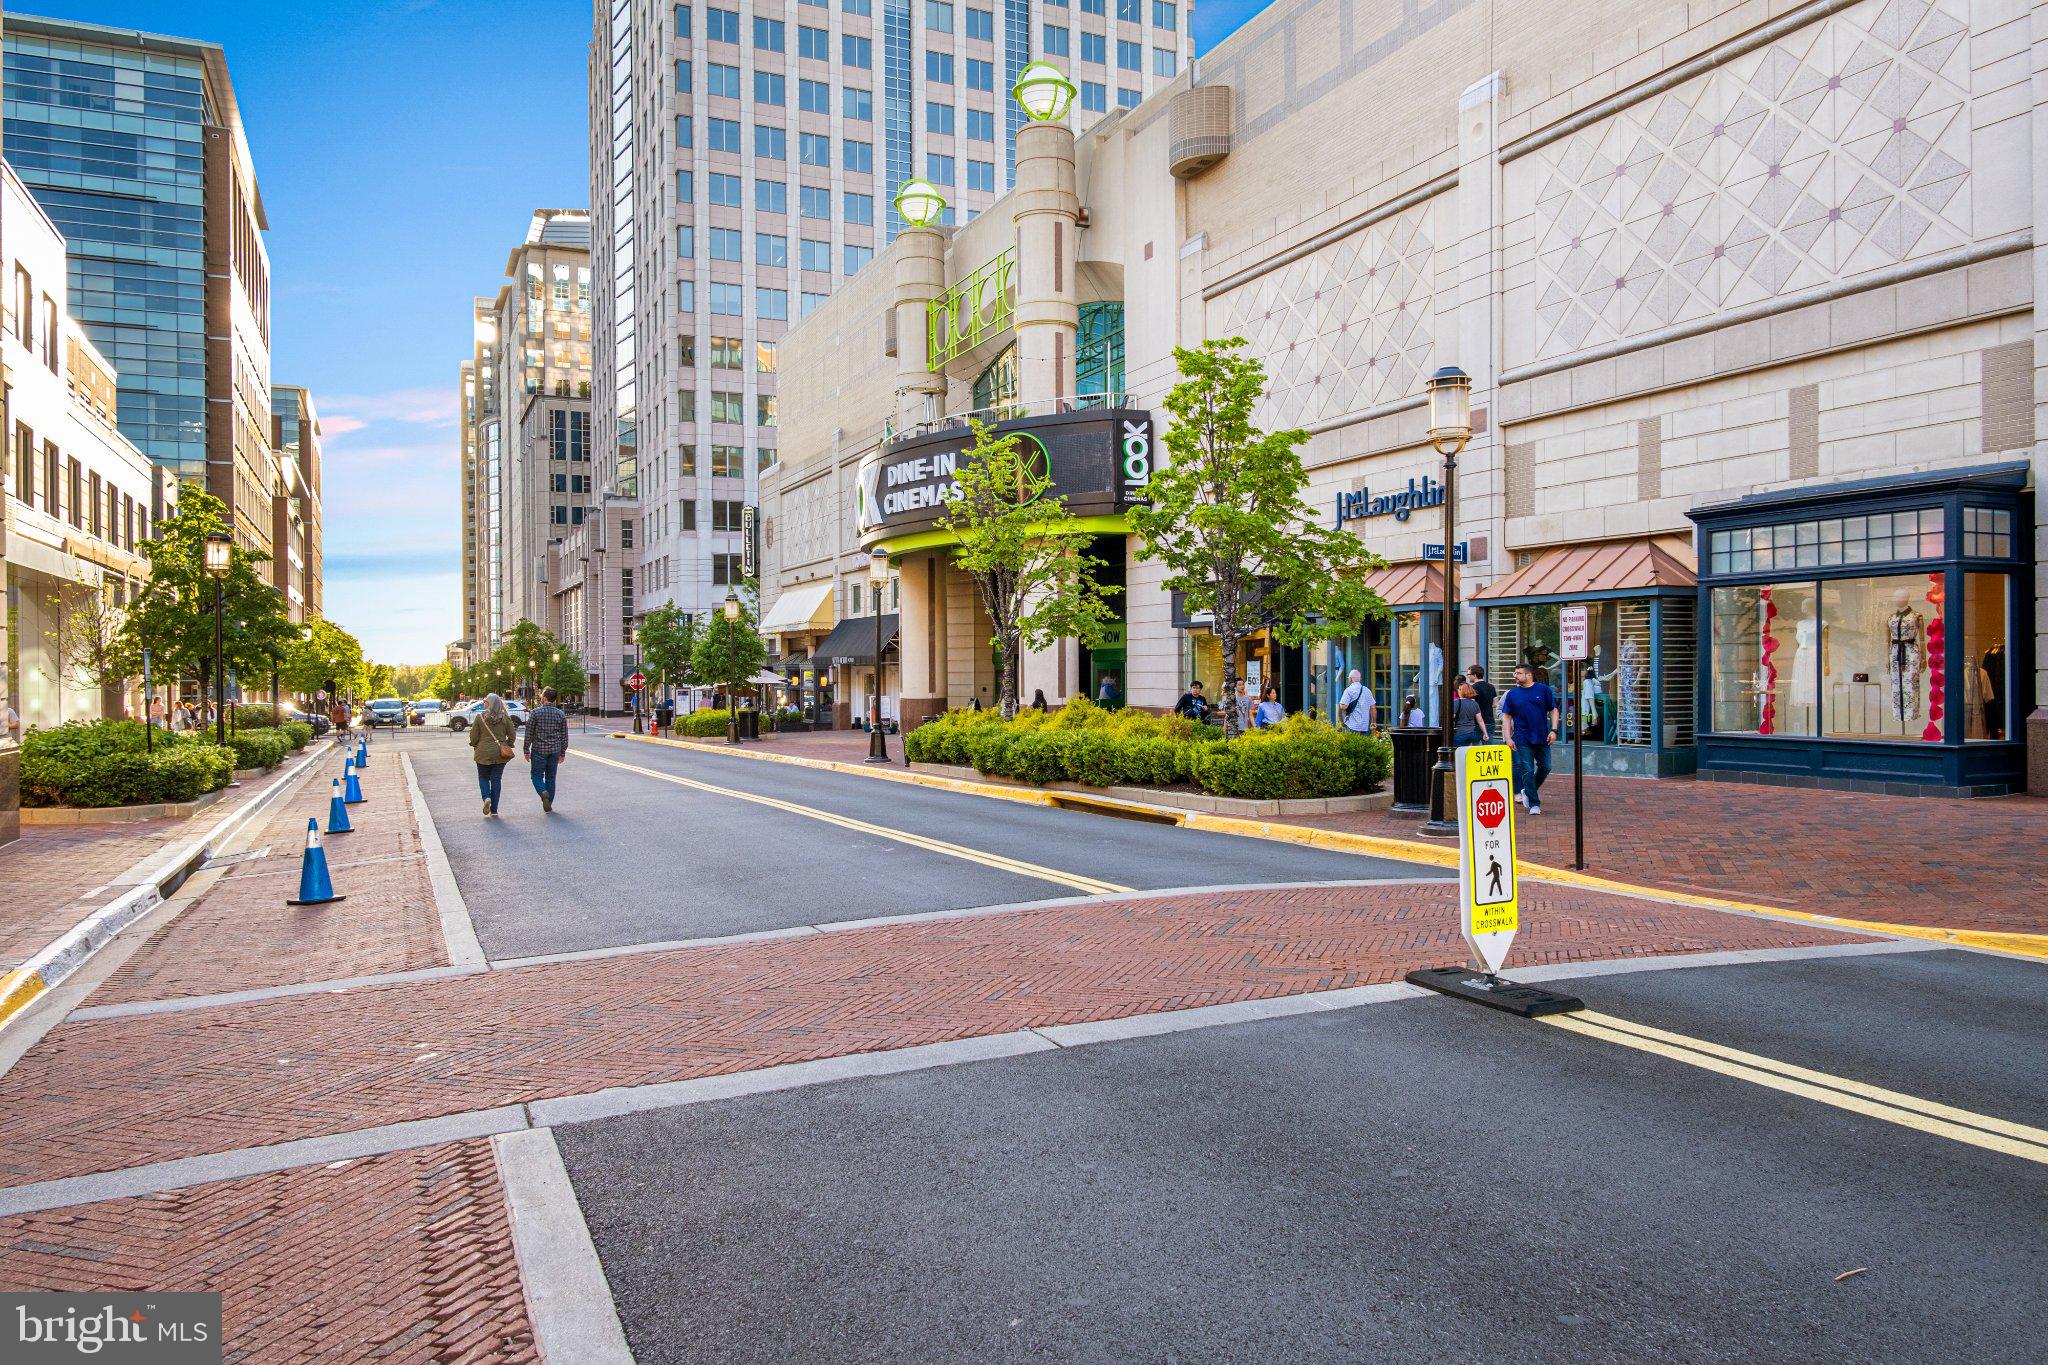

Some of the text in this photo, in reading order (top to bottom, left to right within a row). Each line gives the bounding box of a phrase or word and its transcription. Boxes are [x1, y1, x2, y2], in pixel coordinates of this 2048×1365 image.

[1123, 420, 1149, 486] LOOK
[887, 452, 956, 488] DINE-IN
[883, 480, 965, 515] CINEMAS
[1475, 751, 1504, 763] STATE
[1480, 765, 1500, 777] LAW
[1477, 801, 1504, 817] STOP
[1485, 840, 1500, 850] FOR
[1484, 907, 1505, 916] WITHIN
[1476, 916, 1513, 930] CROSSWALK
